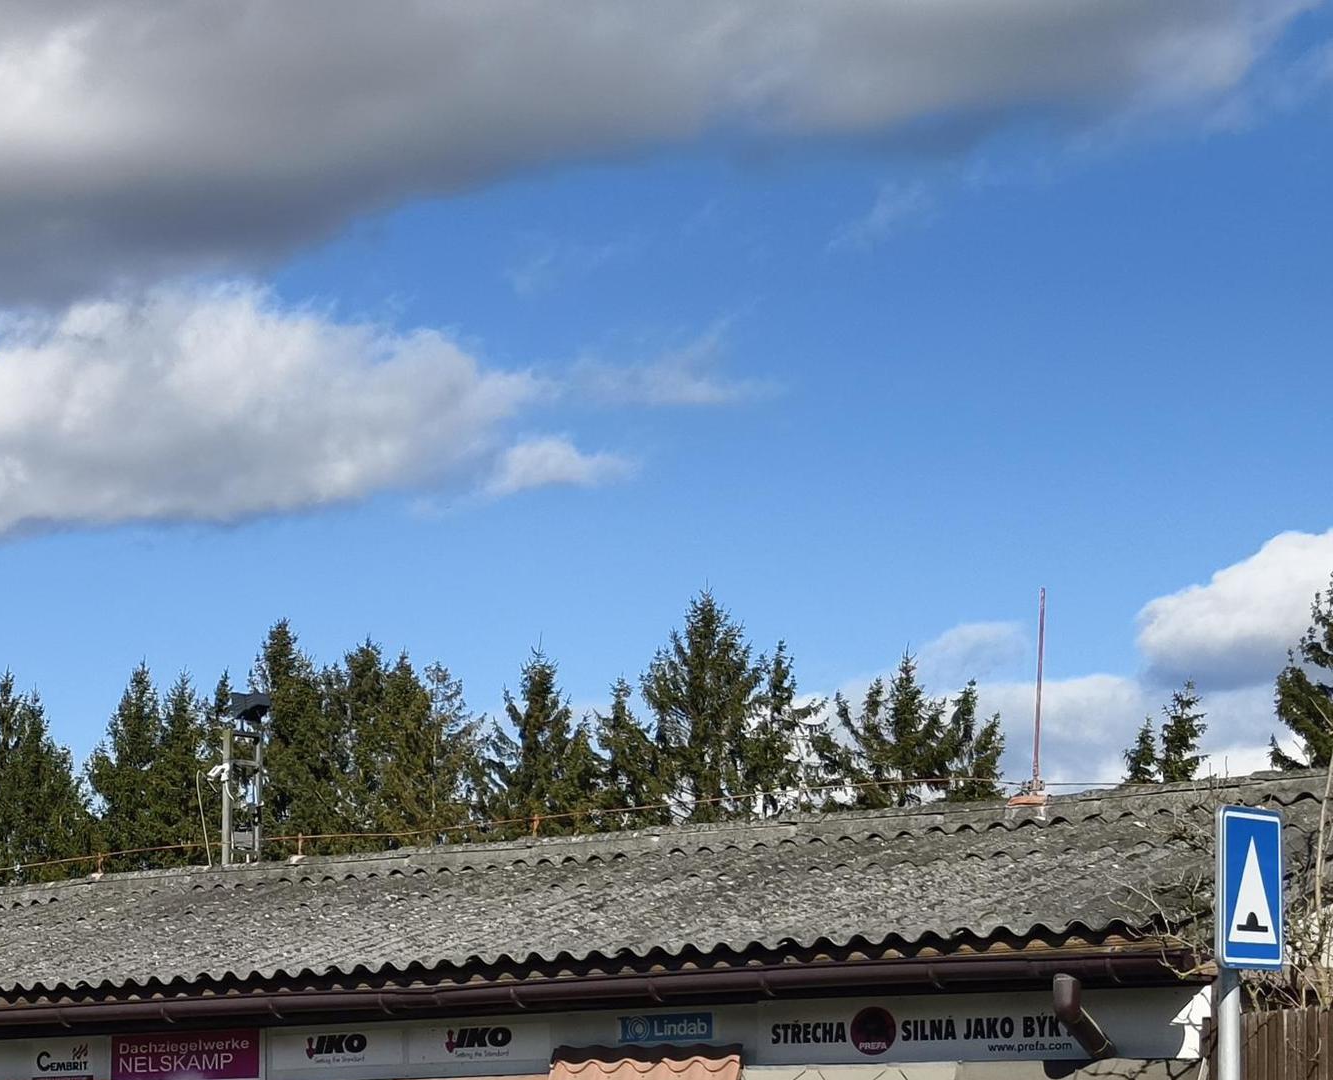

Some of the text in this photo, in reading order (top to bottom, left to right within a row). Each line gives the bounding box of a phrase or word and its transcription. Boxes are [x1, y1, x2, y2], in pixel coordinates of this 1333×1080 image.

[654, 1018, 708, 1036] Lindab
[771, 1019, 847, 1044] STŘECHA
[901, 1015, 957, 1042] SILNÁ
[963, 1016, 1015, 1040] JAKO
[119, 1038, 250, 1055] Dachziegelwerke
[858, 1041, 887, 1050] PREFA
[988, 1041, 1073, 1053] www.prefa.com
[119, 1053, 233, 1073] NELSKAMP
